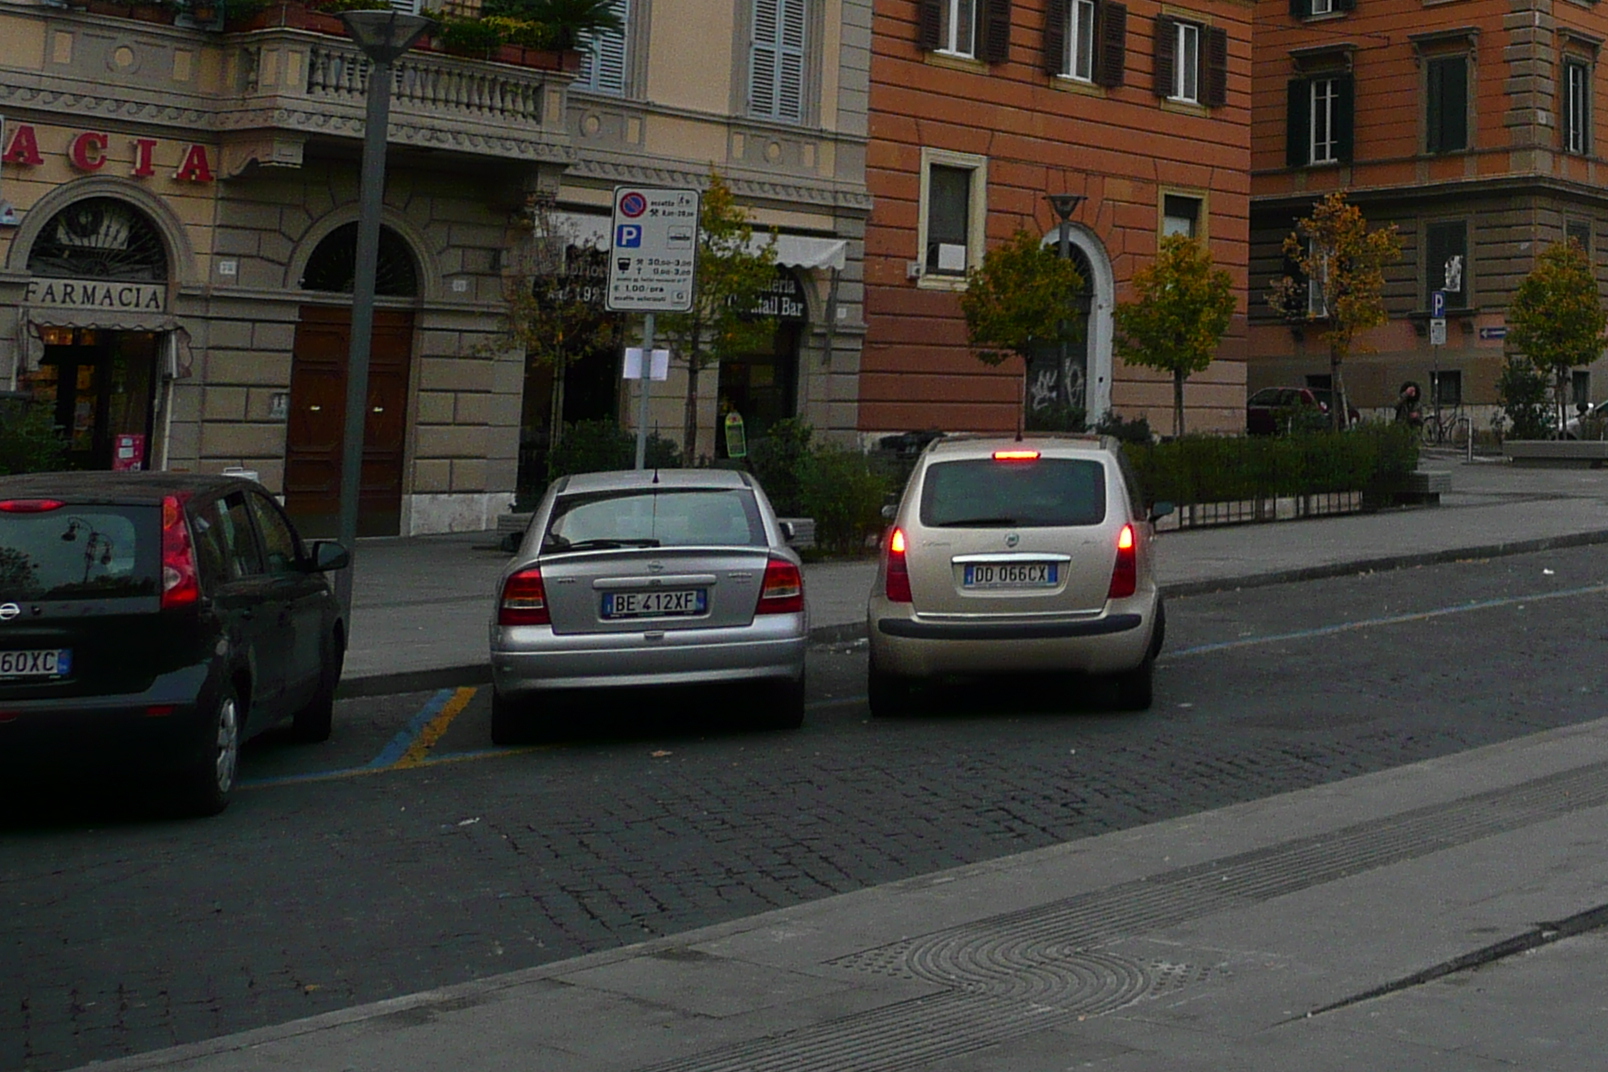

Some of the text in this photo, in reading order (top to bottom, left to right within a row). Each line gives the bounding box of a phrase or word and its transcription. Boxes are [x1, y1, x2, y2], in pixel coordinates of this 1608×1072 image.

[621, 226, 638, 246] P
[24, 281, 161, 310] FARMACIA
[1434, 293, 1443, 316] P
[781, 296, 804, 316] Bar
[975, 566, 1046, 583] DD 066CX
[616, 592, 694, 612] BE 412XF
